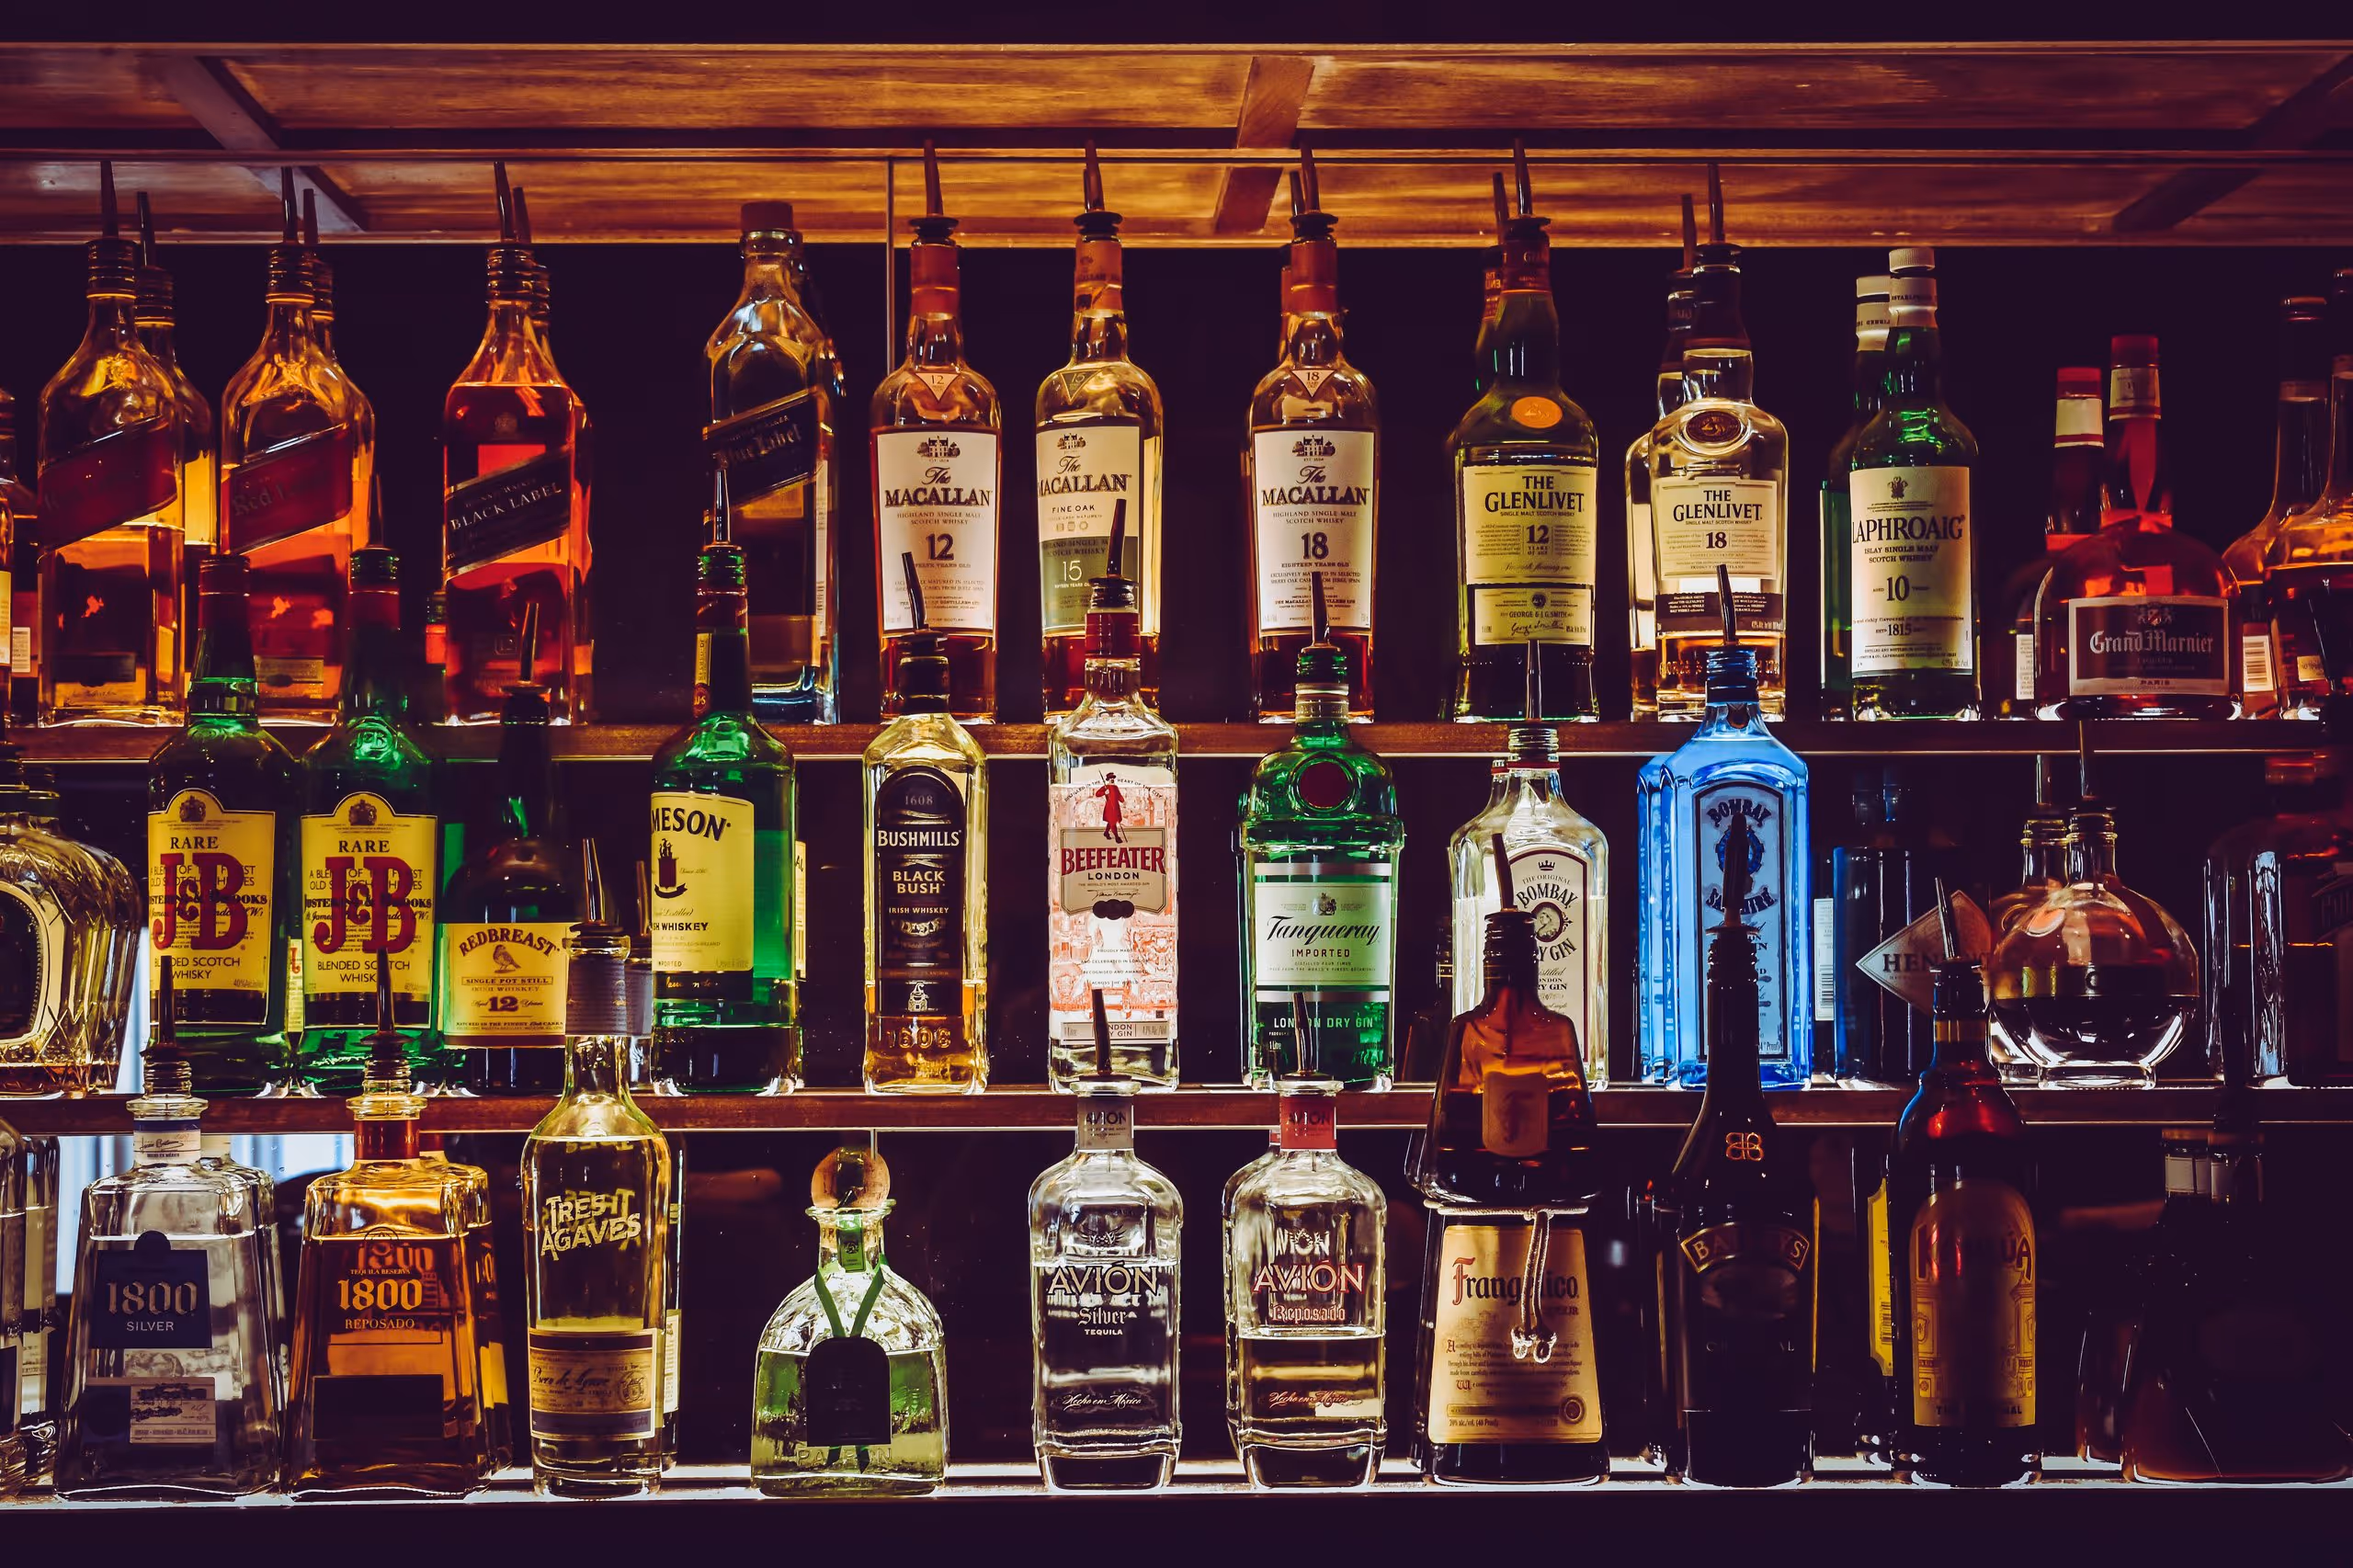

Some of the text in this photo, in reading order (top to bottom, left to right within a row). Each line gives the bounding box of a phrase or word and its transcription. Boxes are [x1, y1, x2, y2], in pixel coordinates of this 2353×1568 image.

[930, 374, 945, 385] 12
[1071, 373, 1086, 384] 15
[1306, 371, 1320, 381] 18
[1057, 455, 1081, 475] The
[921, 466, 952, 485] The
[1296, 465, 1326, 484] The
[1522, 475, 1554, 490] THE
[1038, 473, 1129, 497] MACALLAN
[884, 487, 992, 507] MACALLAN
[1261, 486, 1370, 506] MACALLAN
[1485, 492, 1585, 512] GLENLIVET
[1703, 490, 1732, 502] THE
[449, 504, 506, 531] BLACK
[509, 481, 562, 509] LABEL
[1051, 506, 1073, 514] FINE
[1673, 504, 1762, 522] GLENLIVET
[1526, 524, 1550, 544] 12
[1852, 515, 1963, 544] LAPHROAIG
[926, 533, 954, 561] 12
[1301, 531, 1329, 560] 18
[1705, 531, 1727, 549] 18
[1884, 545, 1915, 553] SINGLE
[1916, 544, 1939, 552] MALT
[1869, 555, 1897, 563] SCOTCH
[1063, 560, 1083, 582] 15
[1886, 574, 1911, 601] 10
[1888, 623, 1912, 636] 1815
[2089, 629, 2213, 654] Grand Marnier
[904, 794, 934, 806] 1608
[170, 835, 219, 849] RARE
[338, 840, 391, 853] RARE
[877, 830, 960, 847] BUSHMILLS
[178, 865, 192, 874] OF
[1061, 846, 1166, 877] BEEFEATER
[309, 869, 363, 879] A OF
[892, 870, 945, 882] BLACK
[1087, 871, 1140, 881] LONDON
[1521, 874, 1571, 885] THE ORIGINAL
[310, 881, 326, 891] OLD
[896, 882, 940, 894] BUSH
[1516, 882, 1578, 909] BOMBAY
[661, 922, 709, 931] WHISKEY
[1267, 915, 1381, 947] Tanqueray
[459, 927, 557, 957] REDBREAST
[1550, 937, 1577, 961] GIN
[193, 957, 240, 967] SCOTCH
[1291, 949, 1350, 958] IMPORTED
[317, 960, 361, 971] BLENDED
[172, 970, 212, 980] WHISKY
[339, 973, 377, 983] WHISK
[488, 995, 518, 1012] 12
[1274, 1017, 1373, 1028] LONON DRY GIN
[545, 1194, 607, 1234] TRES
[540, 1212, 642, 1261] AGAVES
[1047, 1259, 1159, 1297] AVIÓN
[1251, 1259, 1365, 1294] AVIÓN
[106, 1281, 199, 1316] 1800
[337, 1278, 423, 1311] 1800
[1078, 1306, 1127, 1326] Silver
[1270, 1303, 1346, 1324] Reposado
[126, 1321, 175, 1331] SILVER
[345, 1318, 415, 1329] REPOSADO
[1063, 1393, 1093, 1410] Hecho
[1268, 1391, 1298, 1409] Hecho
